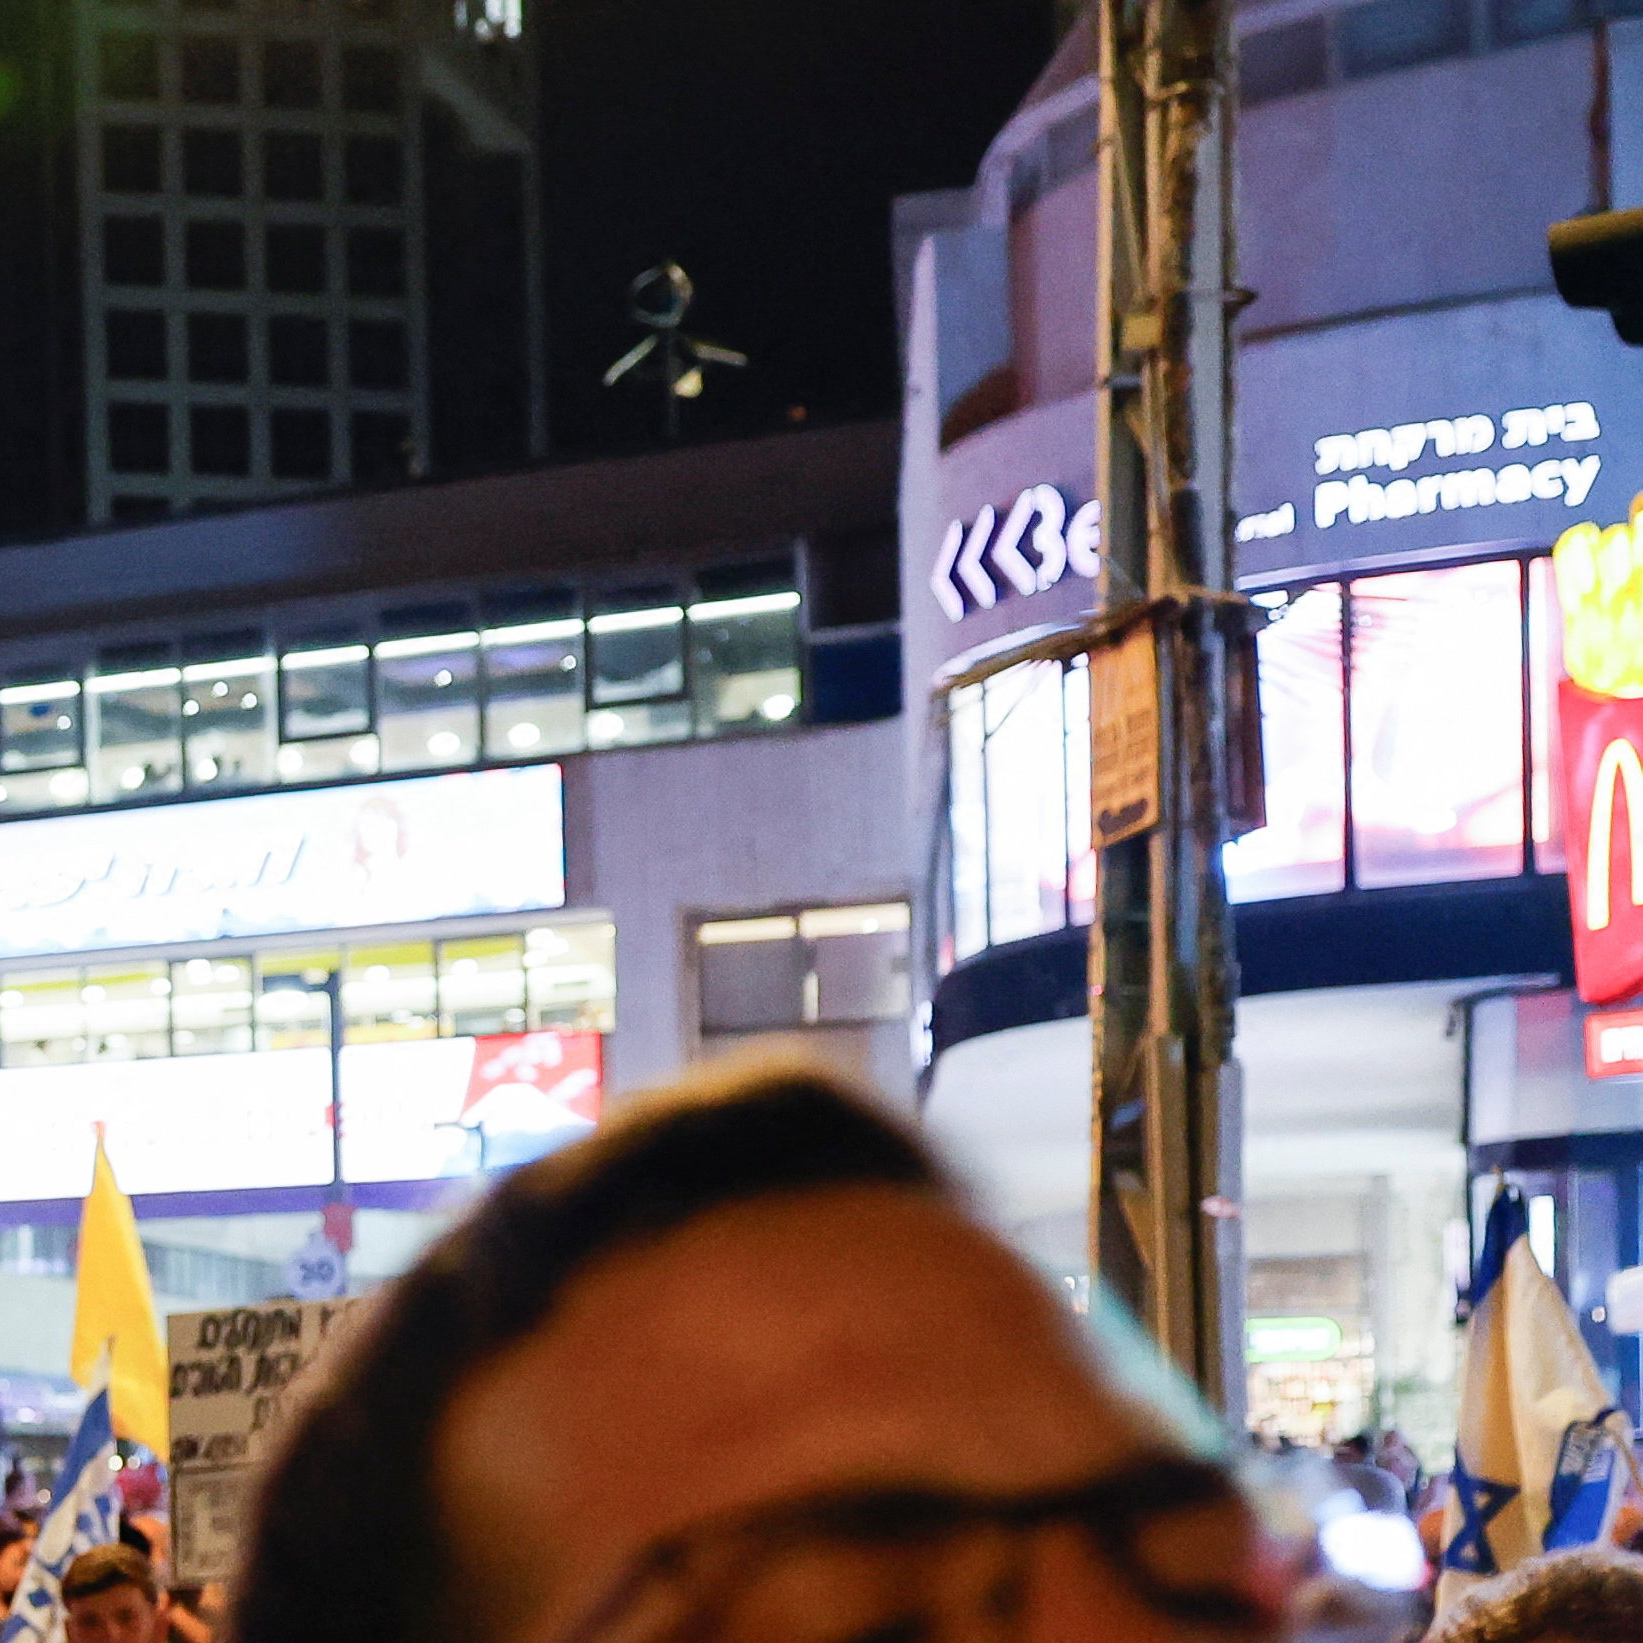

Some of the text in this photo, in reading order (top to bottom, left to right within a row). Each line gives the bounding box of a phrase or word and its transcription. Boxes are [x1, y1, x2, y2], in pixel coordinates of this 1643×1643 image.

[1313, 397, 1602, 475] בית מרקחת
[1313, 454, 1603, 529] Pharmacy
